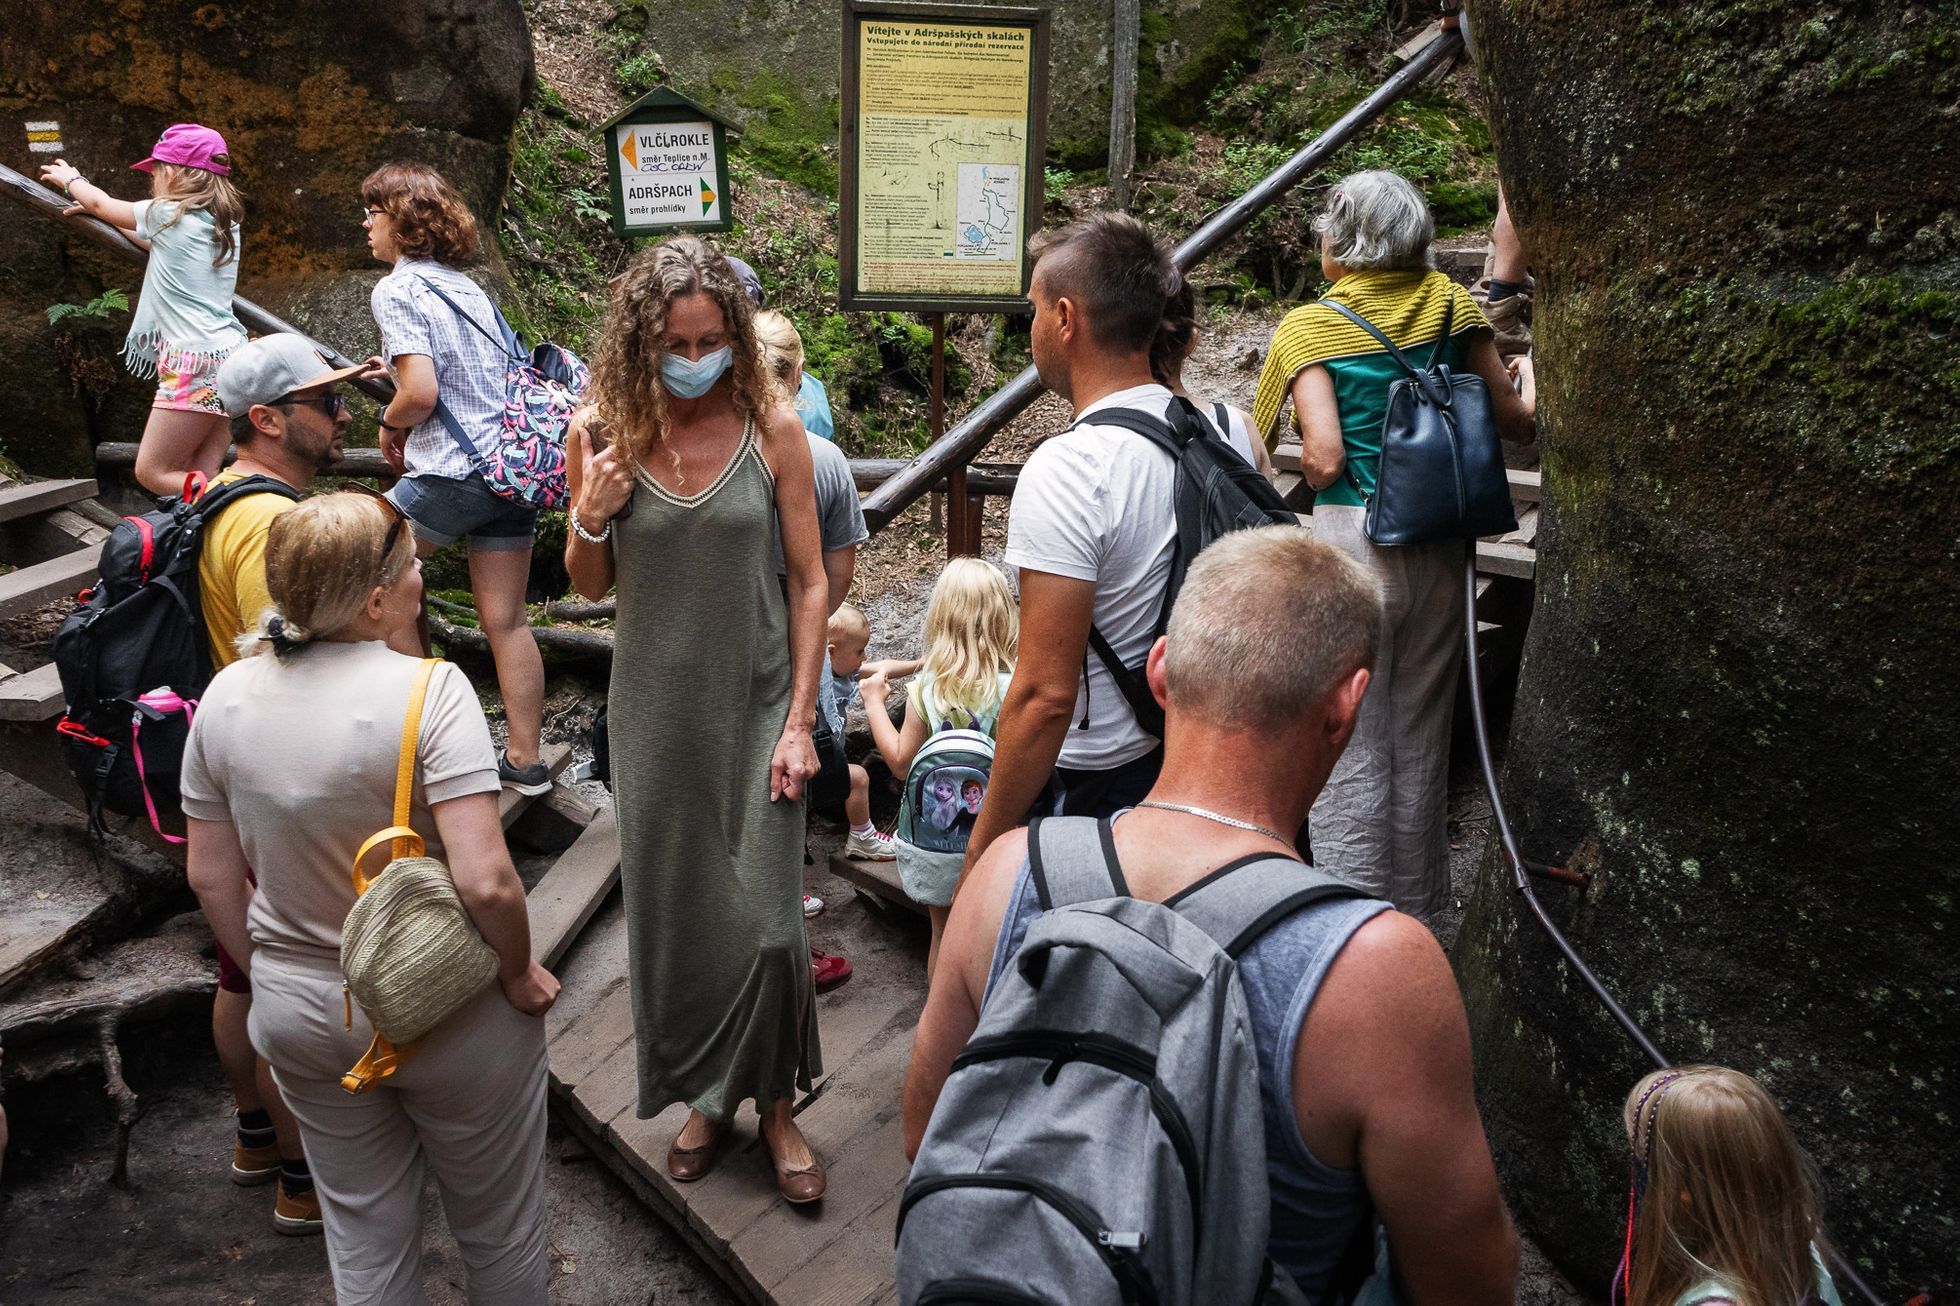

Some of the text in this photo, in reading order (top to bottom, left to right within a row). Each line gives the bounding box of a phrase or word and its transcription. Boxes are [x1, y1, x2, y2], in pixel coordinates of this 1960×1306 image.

[867, 26, 901, 37] Vítejte
[914, 28, 983, 40] Adršpašských
[987, 31, 1024, 41] skalách
[867, 37, 909, 46] Vstupujete
[640, 132, 709, 148] VLČÍ ROKLE
[641, 152, 710, 163] směr Teplice n.M.
[629, 183, 692, 199] ADRŠPACH
[629, 204, 686, 215] směr prohlídky
